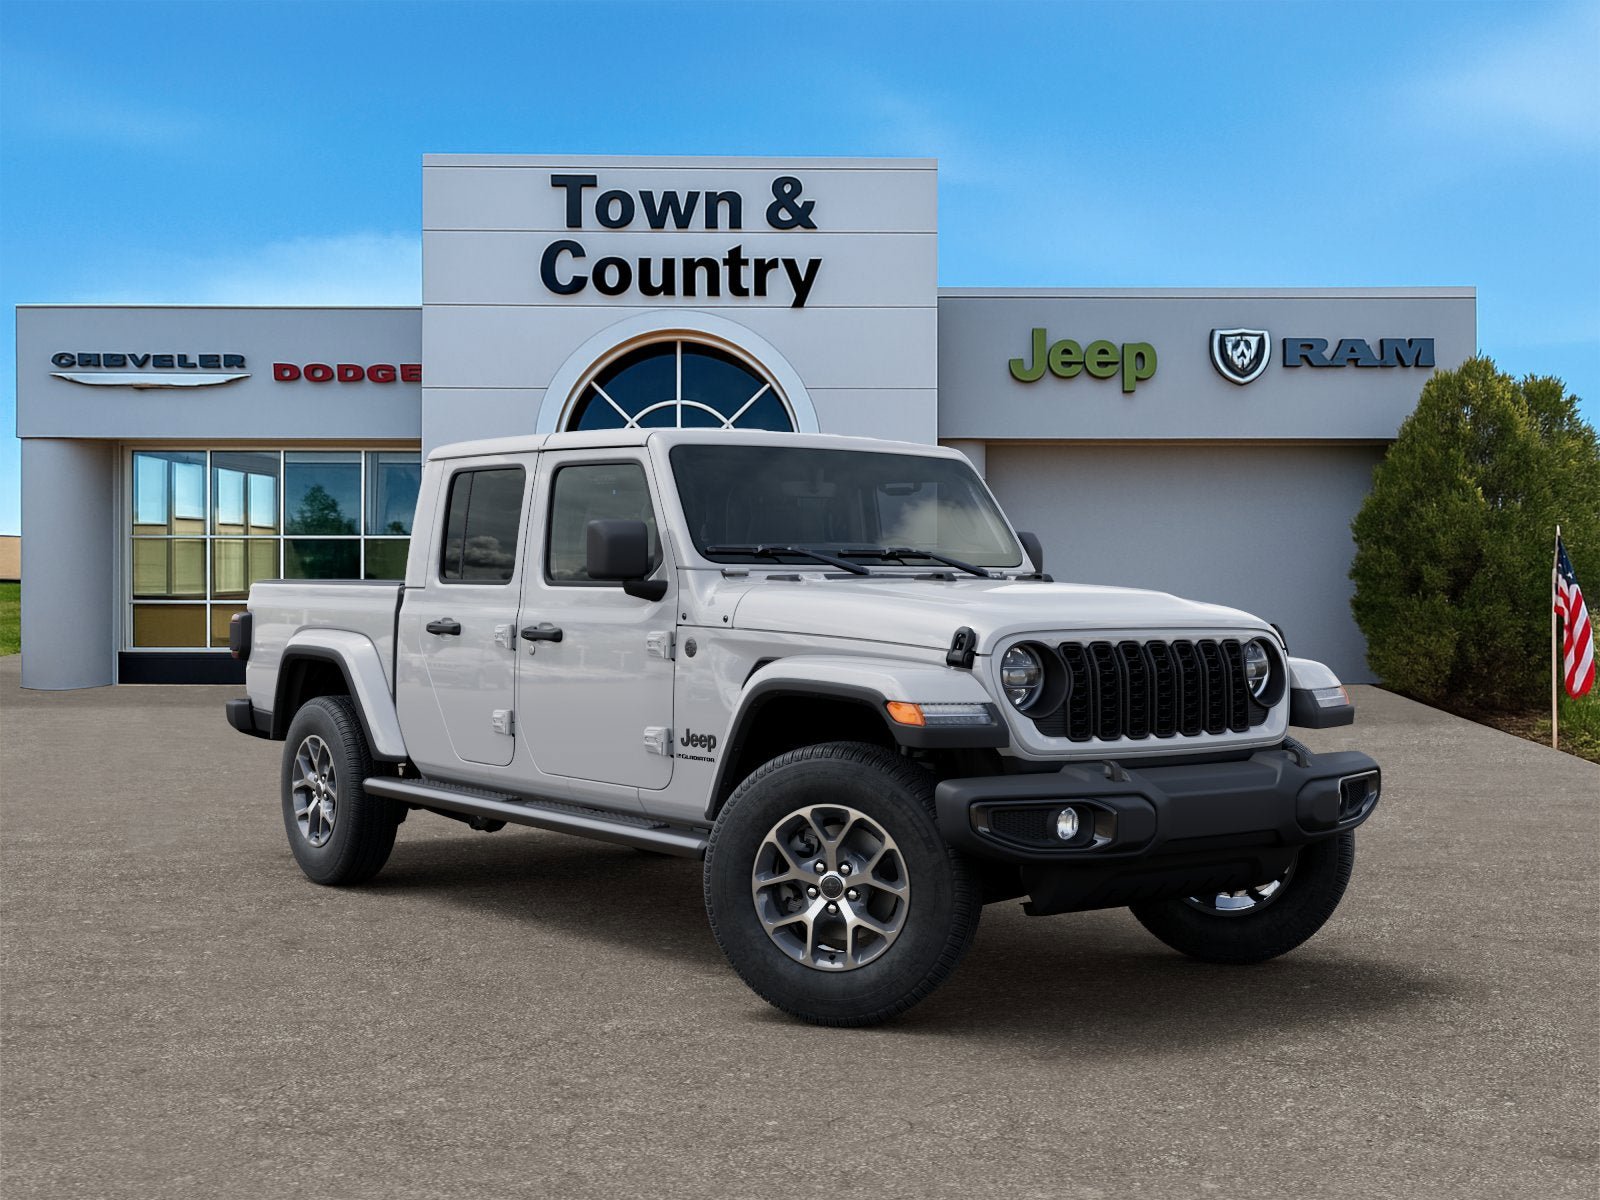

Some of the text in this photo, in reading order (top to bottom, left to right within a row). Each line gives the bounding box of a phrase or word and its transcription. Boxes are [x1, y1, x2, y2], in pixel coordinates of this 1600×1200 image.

[550, 174, 818, 230] Town &
[539, 239, 823, 308] Country
[273, 362, 422, 383] DODGE
[1008, 327, 1158, 393] Jeep
[1282, 337, 1436, 368] RAM
[681, 728, 717, 752] Jeep
